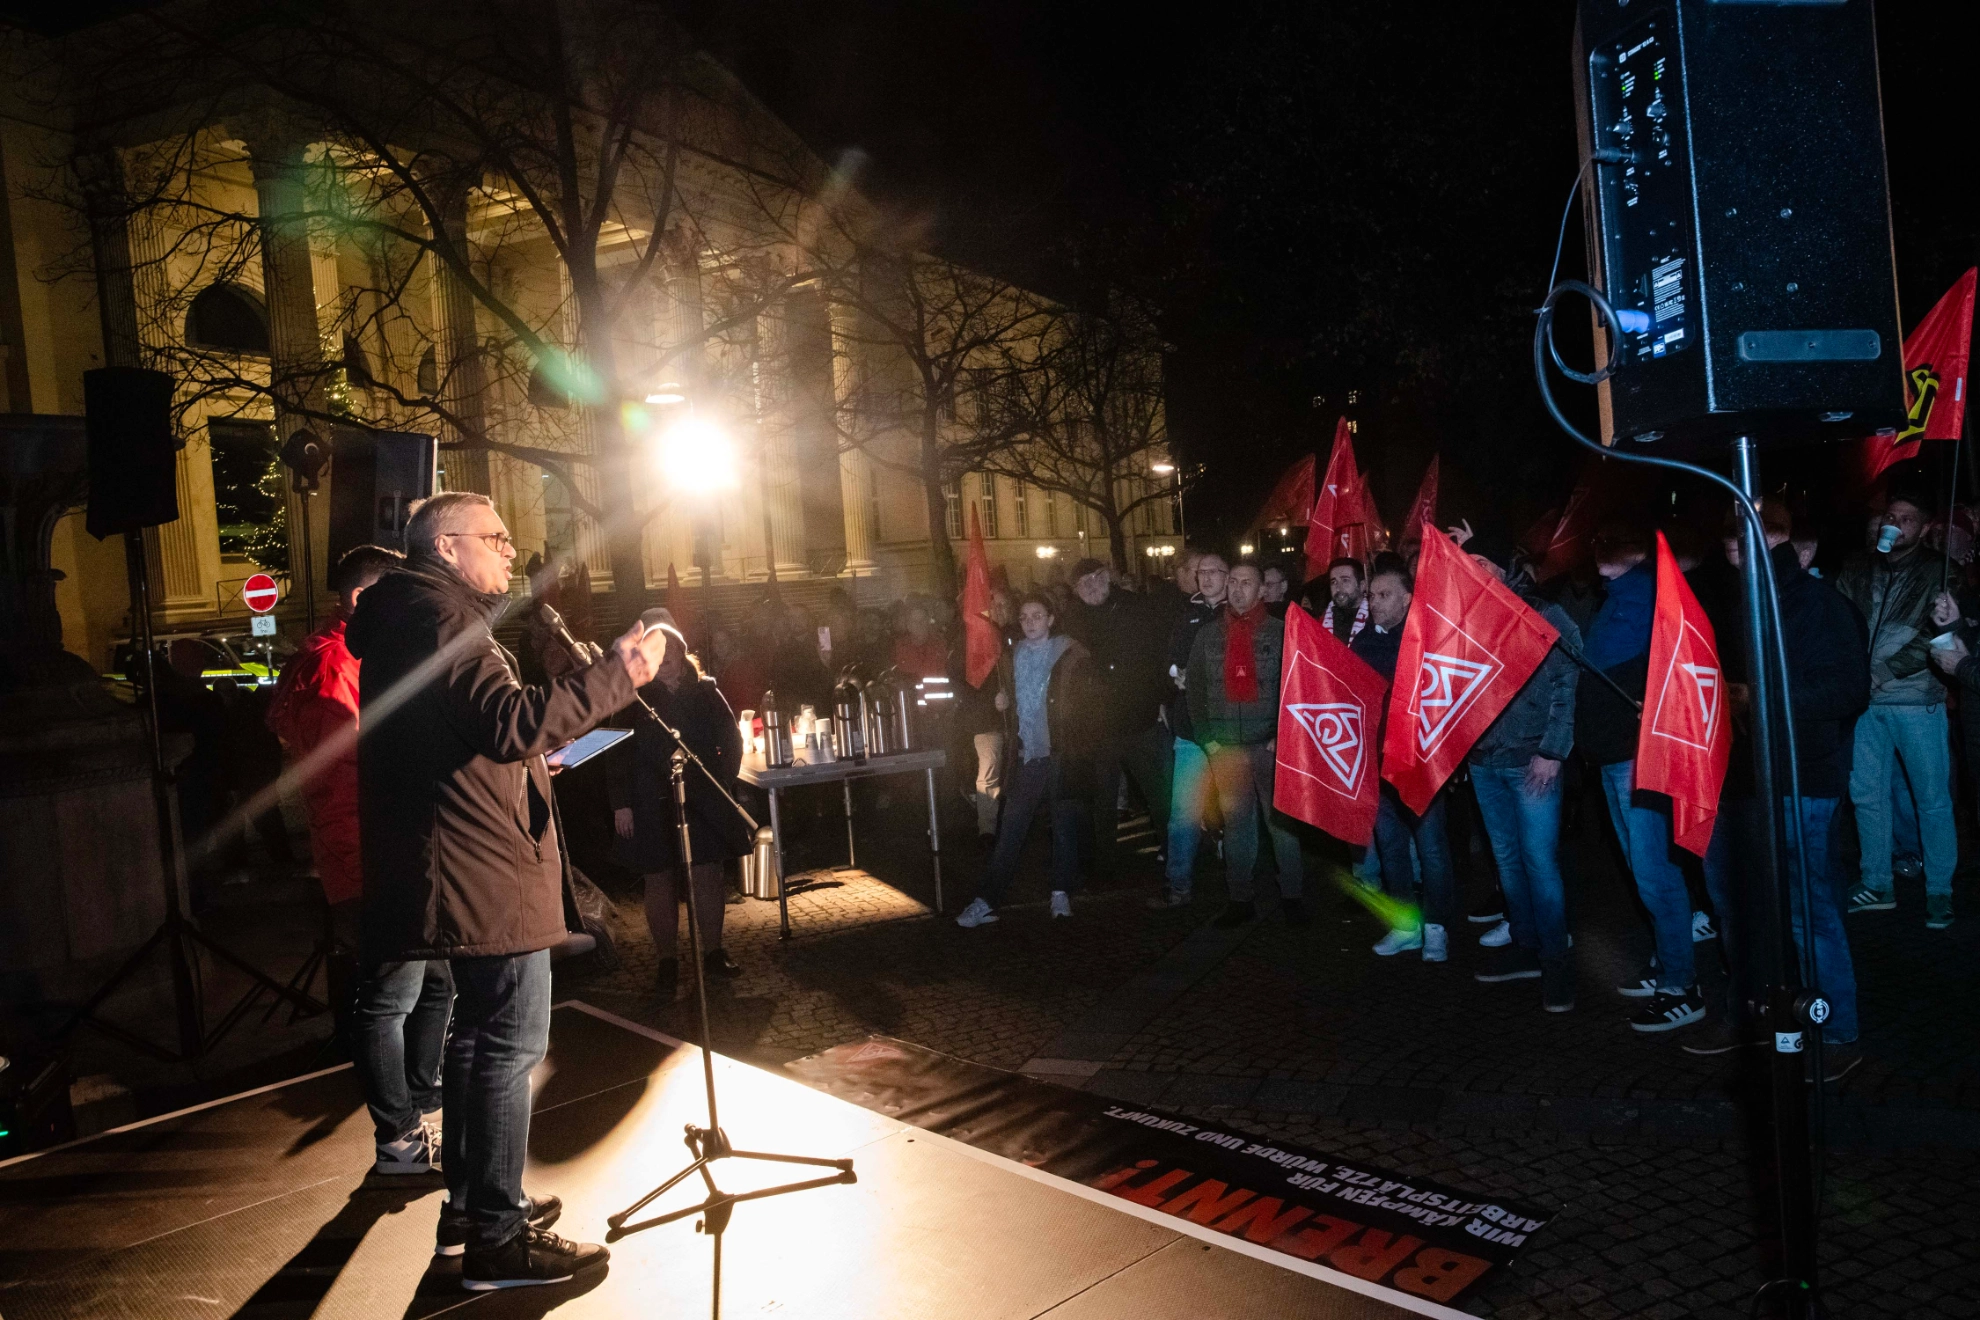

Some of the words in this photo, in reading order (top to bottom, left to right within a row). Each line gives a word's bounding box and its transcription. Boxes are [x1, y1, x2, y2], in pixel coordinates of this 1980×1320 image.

[1103, 1106, 1200, 1137] ZUKUNFT.
[1194, 1131, 1246, 1150] UND
[1240, 1143, 1328, 1174] WÜRDE
[1286, 1172, 1341, 1194] FÜR
[1331, 1165, 1547, 1233] ARBEITSPLÄTZE,
[1335, 1187, 1467, 1227] KÄMPFEN
[1090, 1160, 1494, 1302] BRENNT!
[1464, 1217, 1528, 1247] WIR
